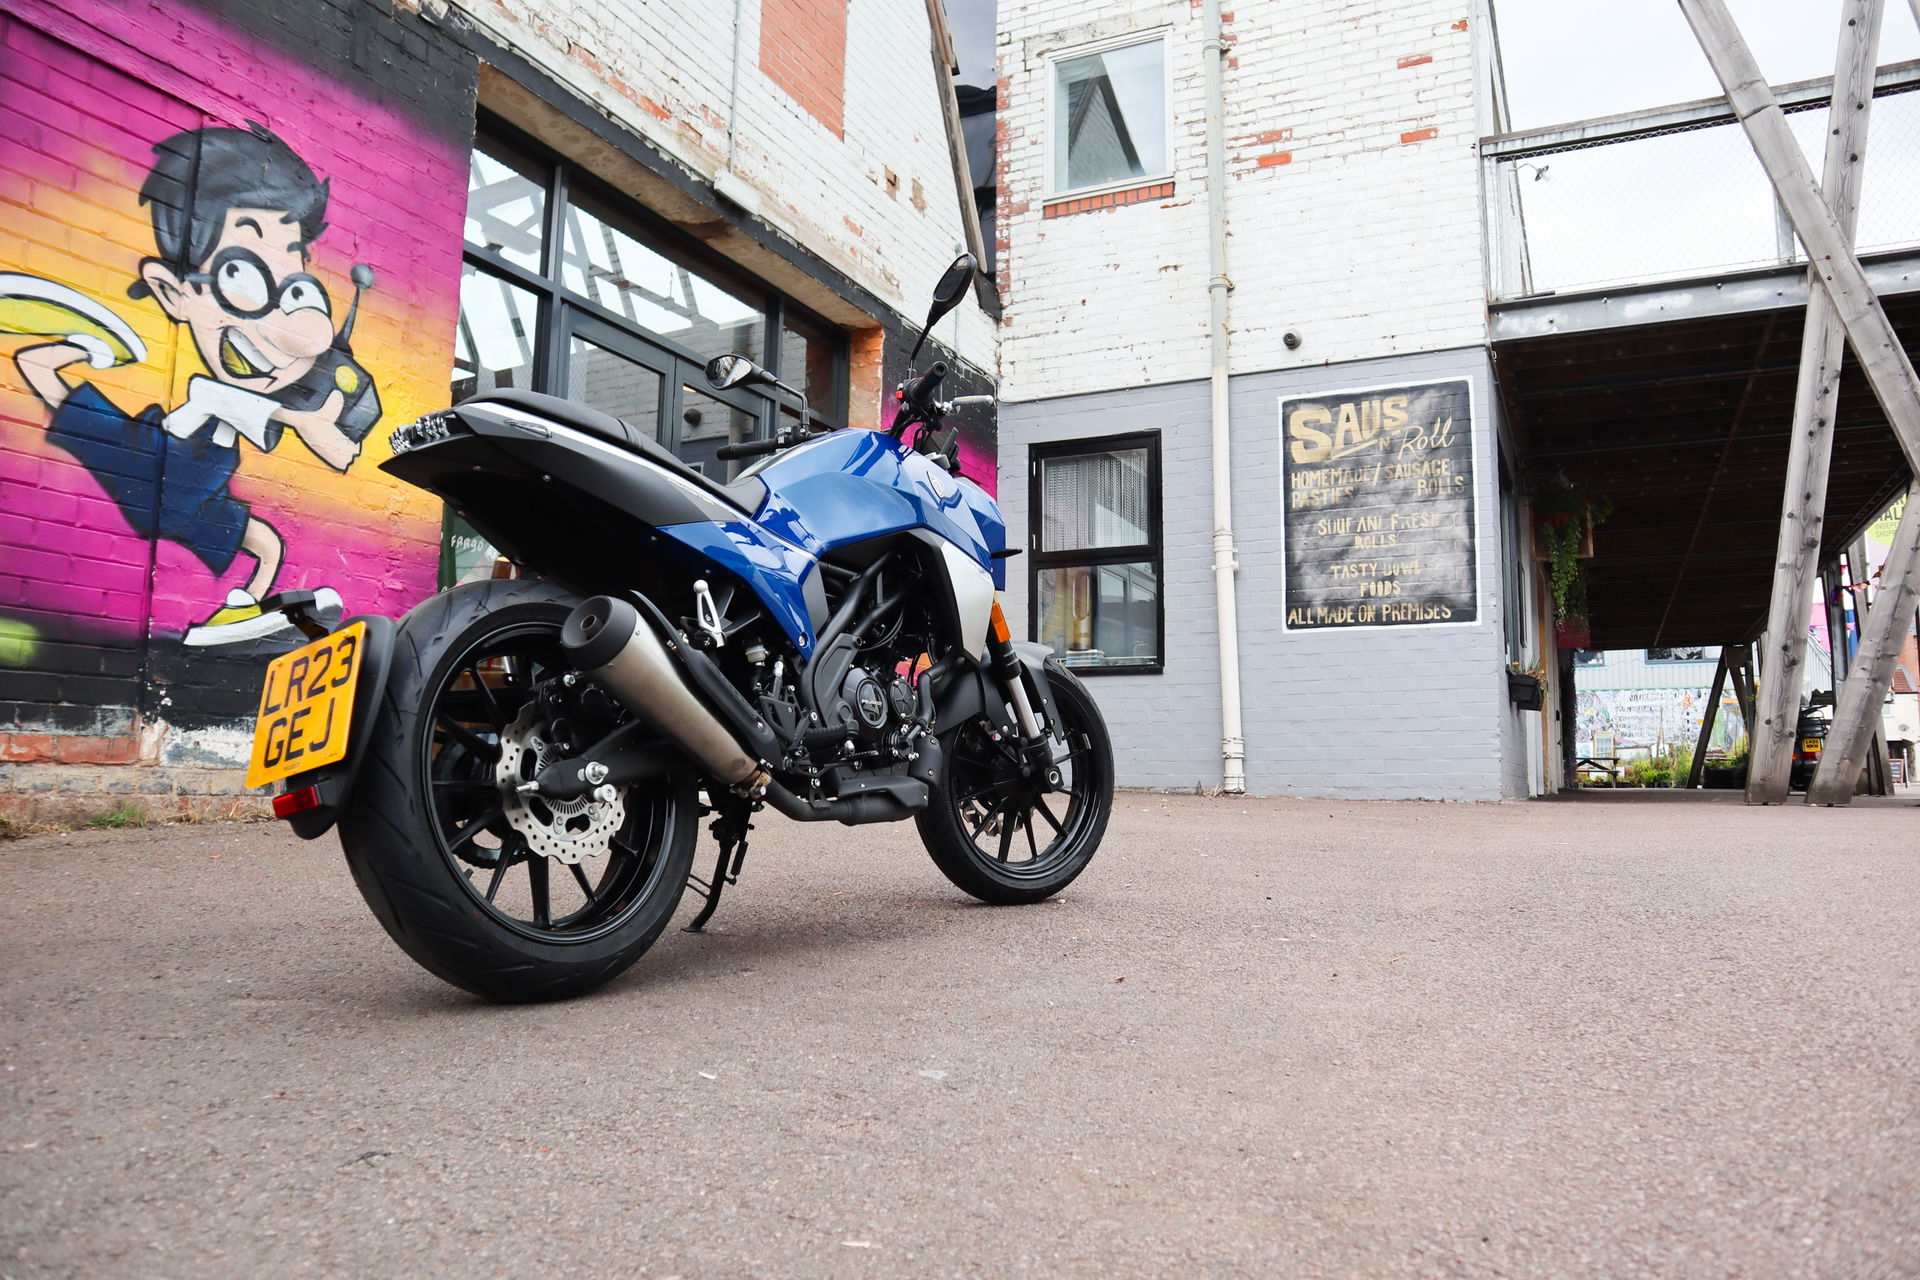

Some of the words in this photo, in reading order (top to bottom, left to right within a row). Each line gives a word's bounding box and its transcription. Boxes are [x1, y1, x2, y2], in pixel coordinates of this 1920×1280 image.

[1290, 396, 1409, 464] SAUS
[1398, 416, 1455, 461] Roll
[1291, 466, 1371, 489] HOMEMADE
[1384, 458, 1451, 481] SAUSAGE
[1291, 486, 1355, 509] PASTIES
[1417, 475, 1465, 497] ROLLS
[1330, 563, 1378, 580] TASTY
[1360, 581, 1401, 598] FOODS
[1287, 607, 1314, 625] ALL
[1316, 604, 1355, 624] MADE
[1358, 604, 1377, 622] ON
[1382, 602, 1452, 622] PREMISES
[263, 635, 356, 717] LR23
[264, 697, 335, 768] GEJ
